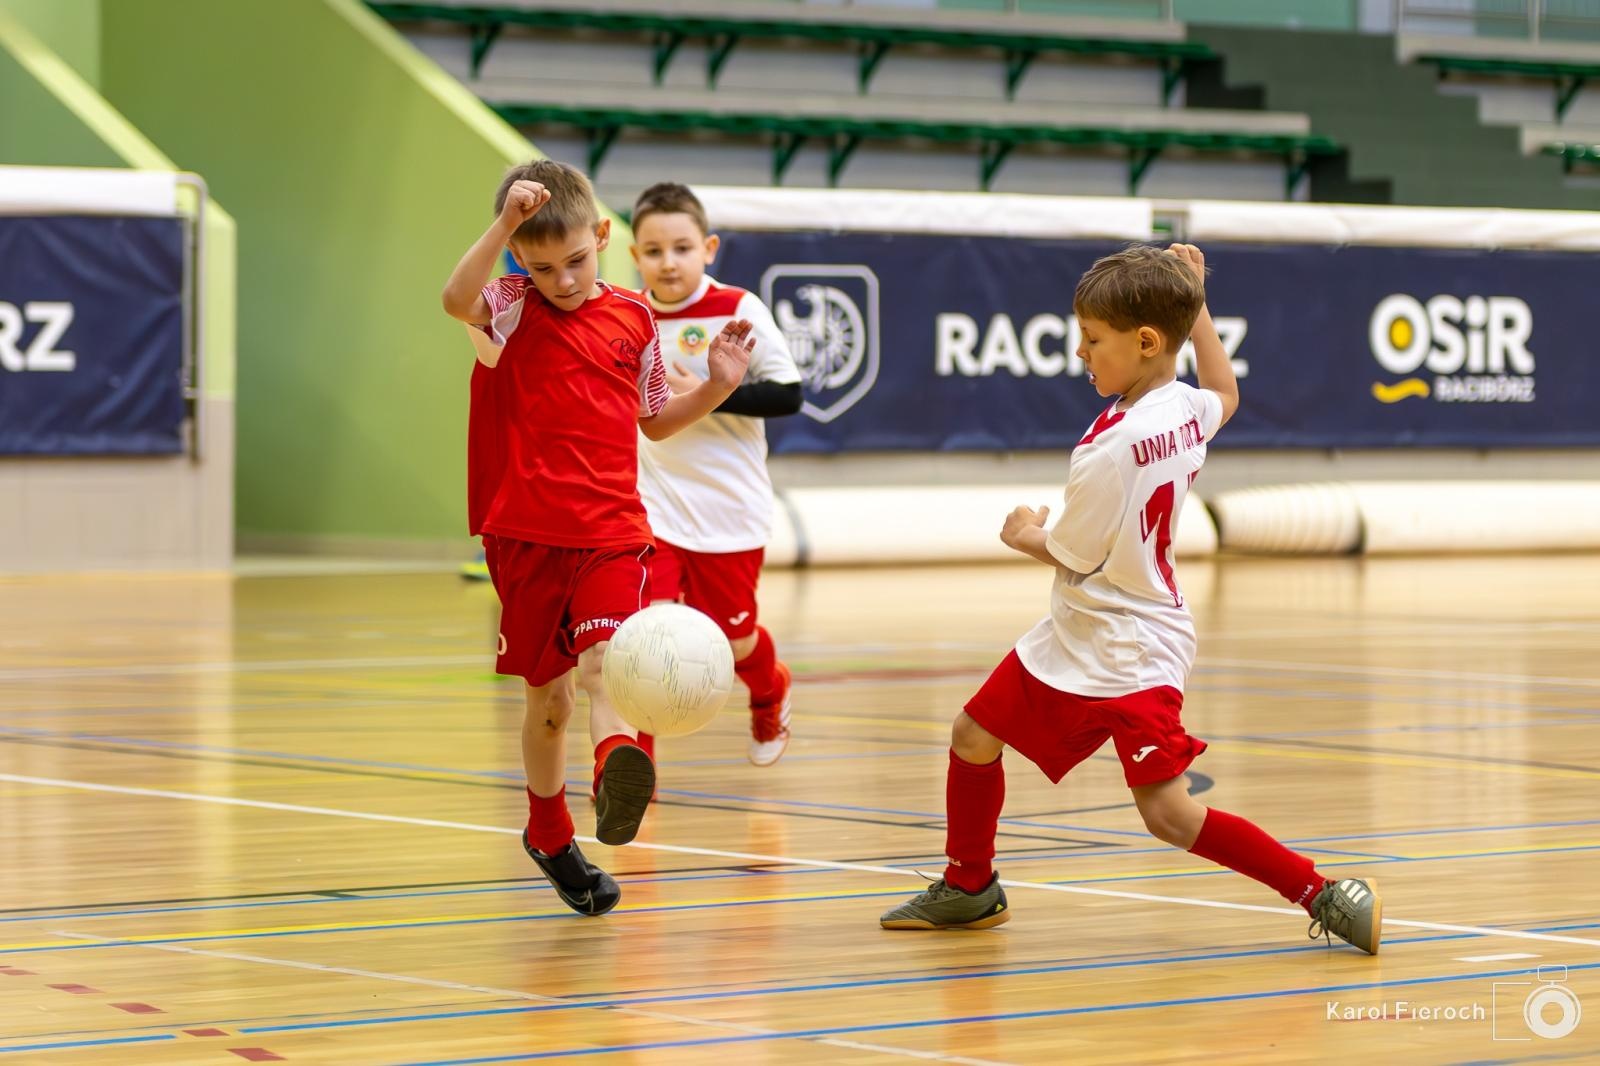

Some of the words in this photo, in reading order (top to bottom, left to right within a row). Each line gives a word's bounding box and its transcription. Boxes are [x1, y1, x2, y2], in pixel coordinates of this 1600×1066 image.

[935, 312, 1249, 379] RACIZ
[1369, 294, 1535, 375] OSiR
[1131, 430, 1178, 468] UNIA
